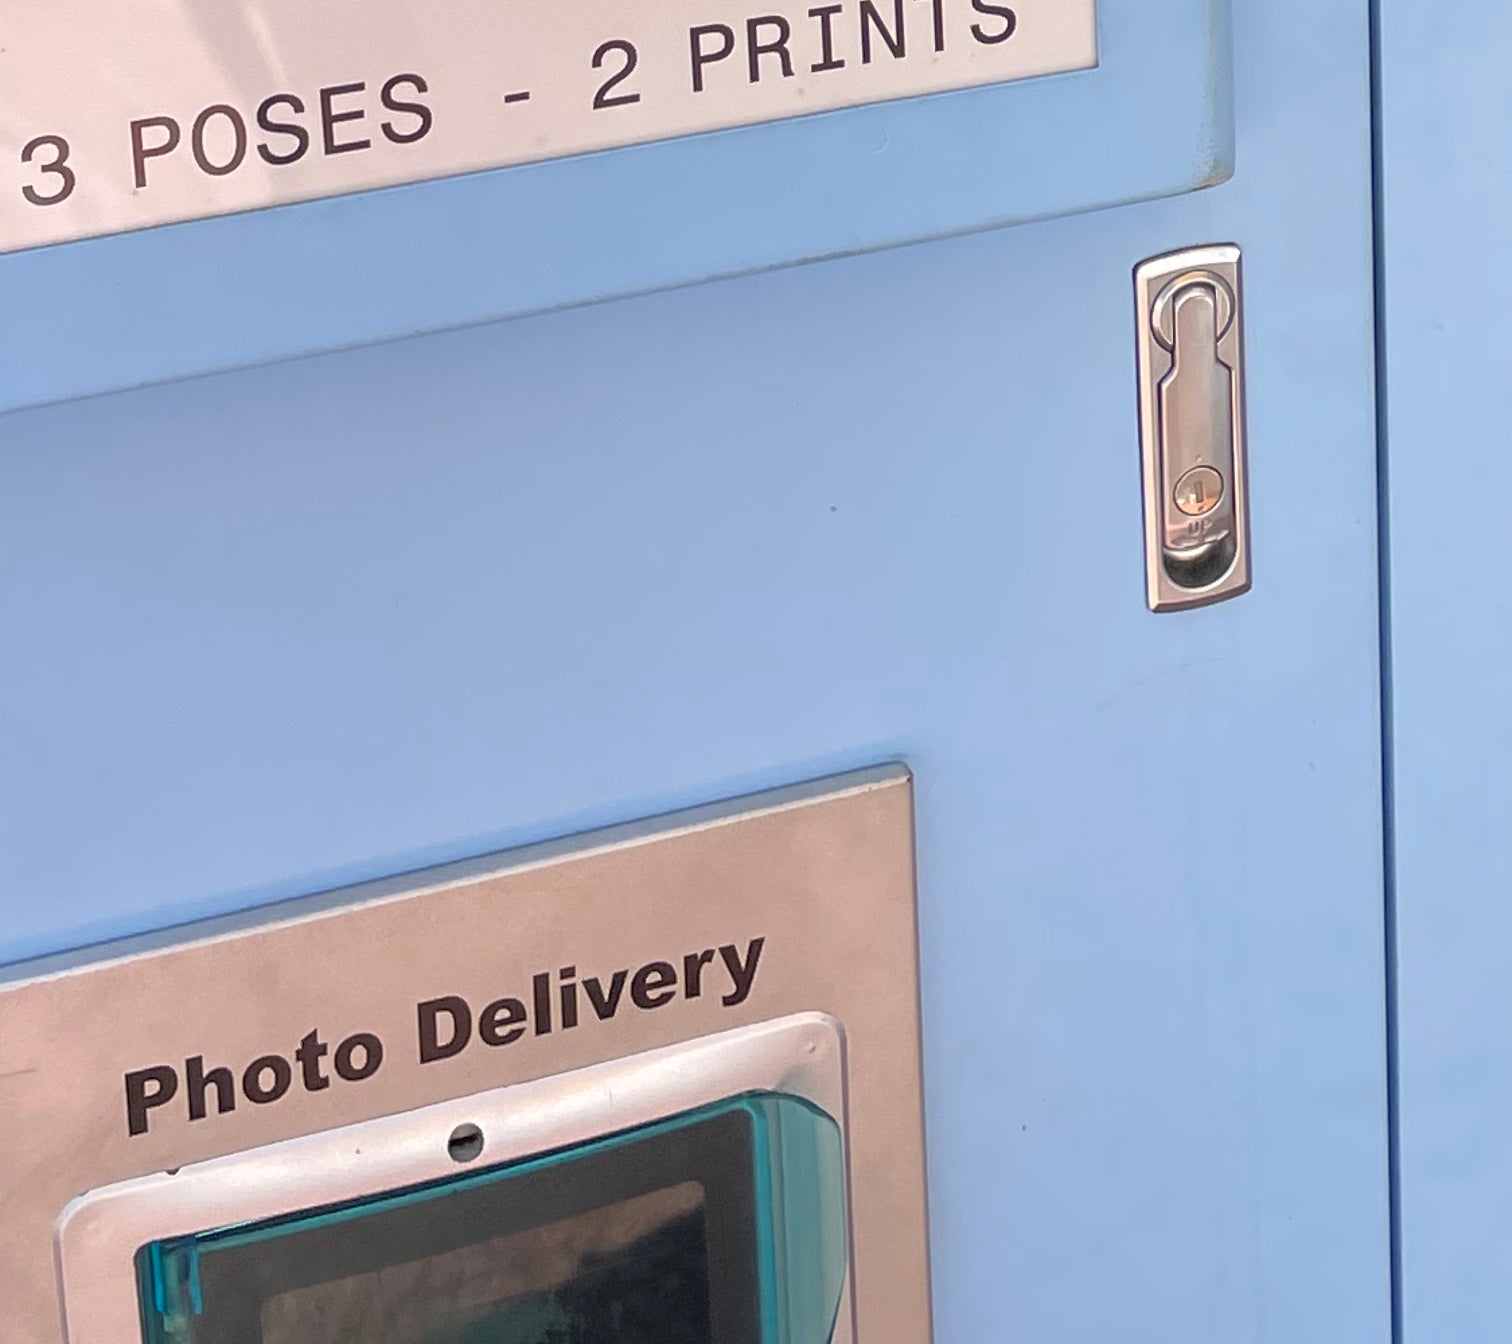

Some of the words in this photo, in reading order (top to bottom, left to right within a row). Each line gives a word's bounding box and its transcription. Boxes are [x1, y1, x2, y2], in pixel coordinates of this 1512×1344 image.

[20, 134, 76, 207] 3
[130, 72, 434, 190] POSES
[590, 38, 641, 111] 2
[124, 1027, 384, 1139] Photo
[416, 936, 766, 1066] Delivery
